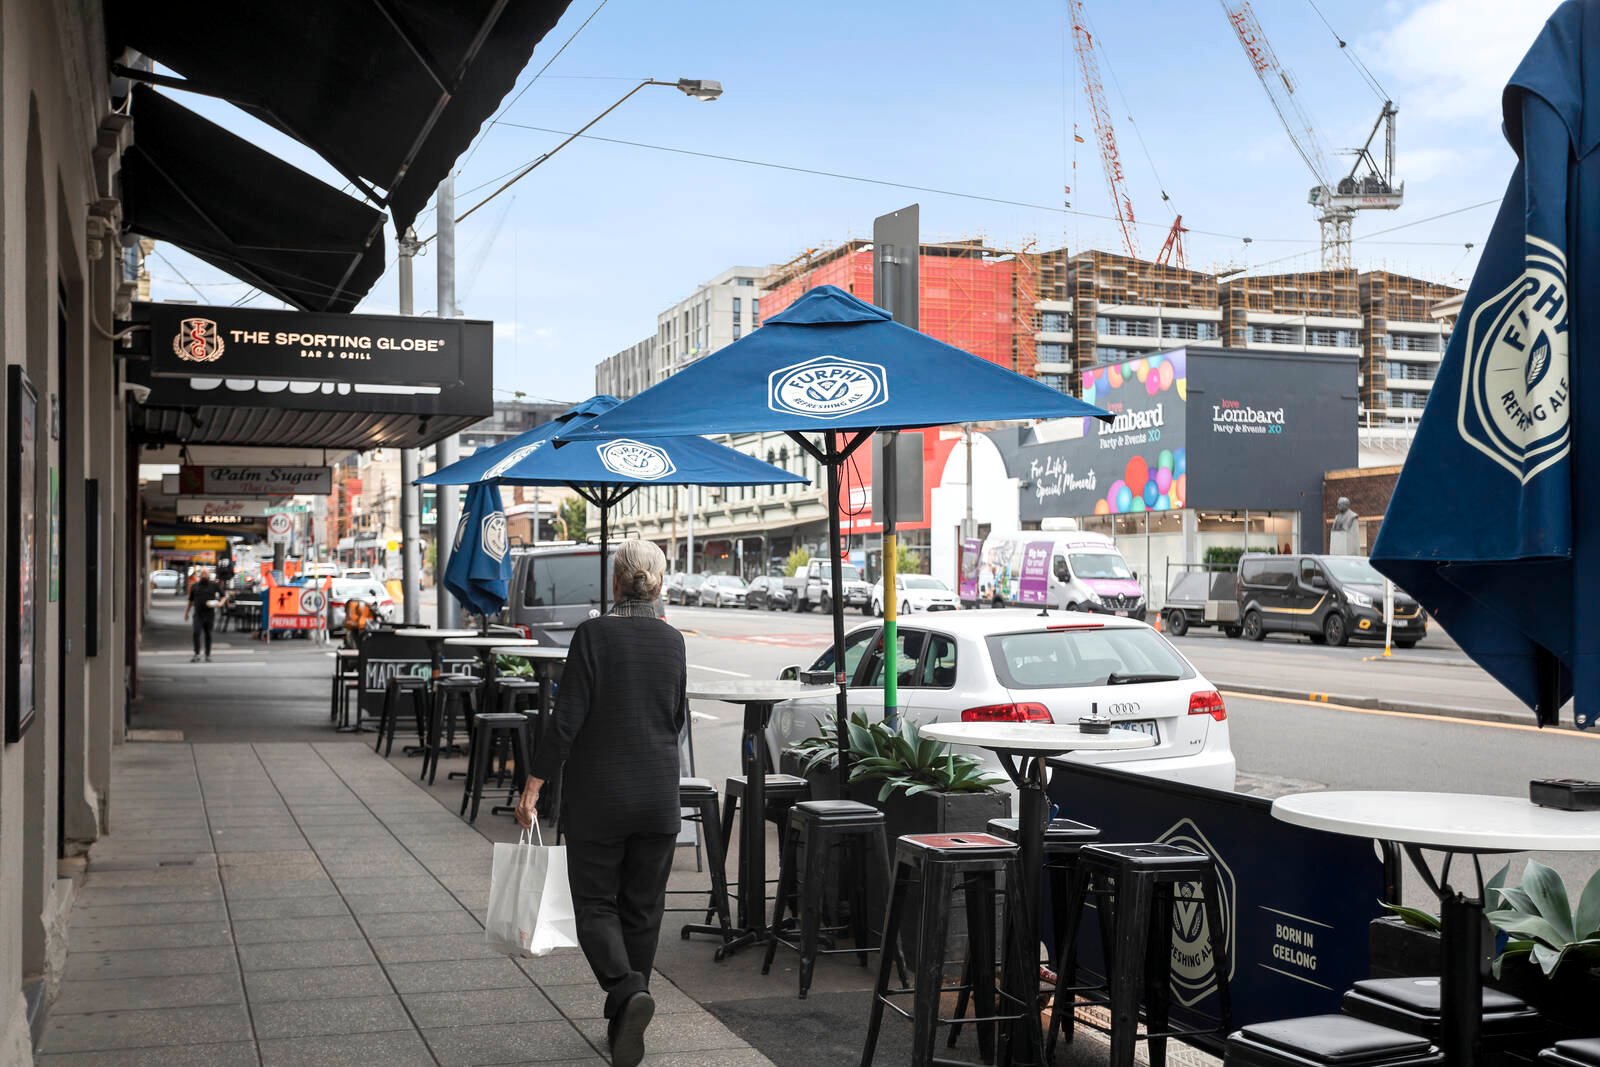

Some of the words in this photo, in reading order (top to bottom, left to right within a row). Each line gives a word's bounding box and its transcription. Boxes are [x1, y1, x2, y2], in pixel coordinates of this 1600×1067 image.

[230, 330, 270, 344] THE
[275, 333, 371, 349] SPORTING
[301, 350, 322, 358] BAR
[340, 351, 372, 360] GRILL
[788, 369, 867, 389] FURPHY
[792, 397, 847, 409] REFRESHING
[849, 392, 864, 404] ALE
[1222, 398, 1240, 409] love
[1212, 406, 1285, 425] Lombard
[1213, 423, 1234, 434] Party
[1235, 424, 1242, 433] &
[1241, 424, 1266, 433] Events
[1268, 424, 1281, 434] XO
[1100, 437, 1118, 450] Party
[1124, 434, 1147, 446] Events
[1147, 428, 1161, 442] XO
[611, 447, 655, 459] FURPHY
[211, 467, 261, 482] Palm
[266, 467, 322, 485] Sugar
[1031, 458, 1044, 479] For
[1045, 455, 1067, 478] Life's
[1036, 478, 1062, 505] Special
[1062, 468, 1096, 495] Moments
[272, 519, 288, 528] 40
[304, 596, 322, 607] 40
[271, 616, 297, 628] PREPARE
[299, 616, 308, 628] TO
[1276, 923, 1302, 945] BORN
[1303, 931, 1314, 949] IN
[1272, 943, 1317, 970] GEELONG
